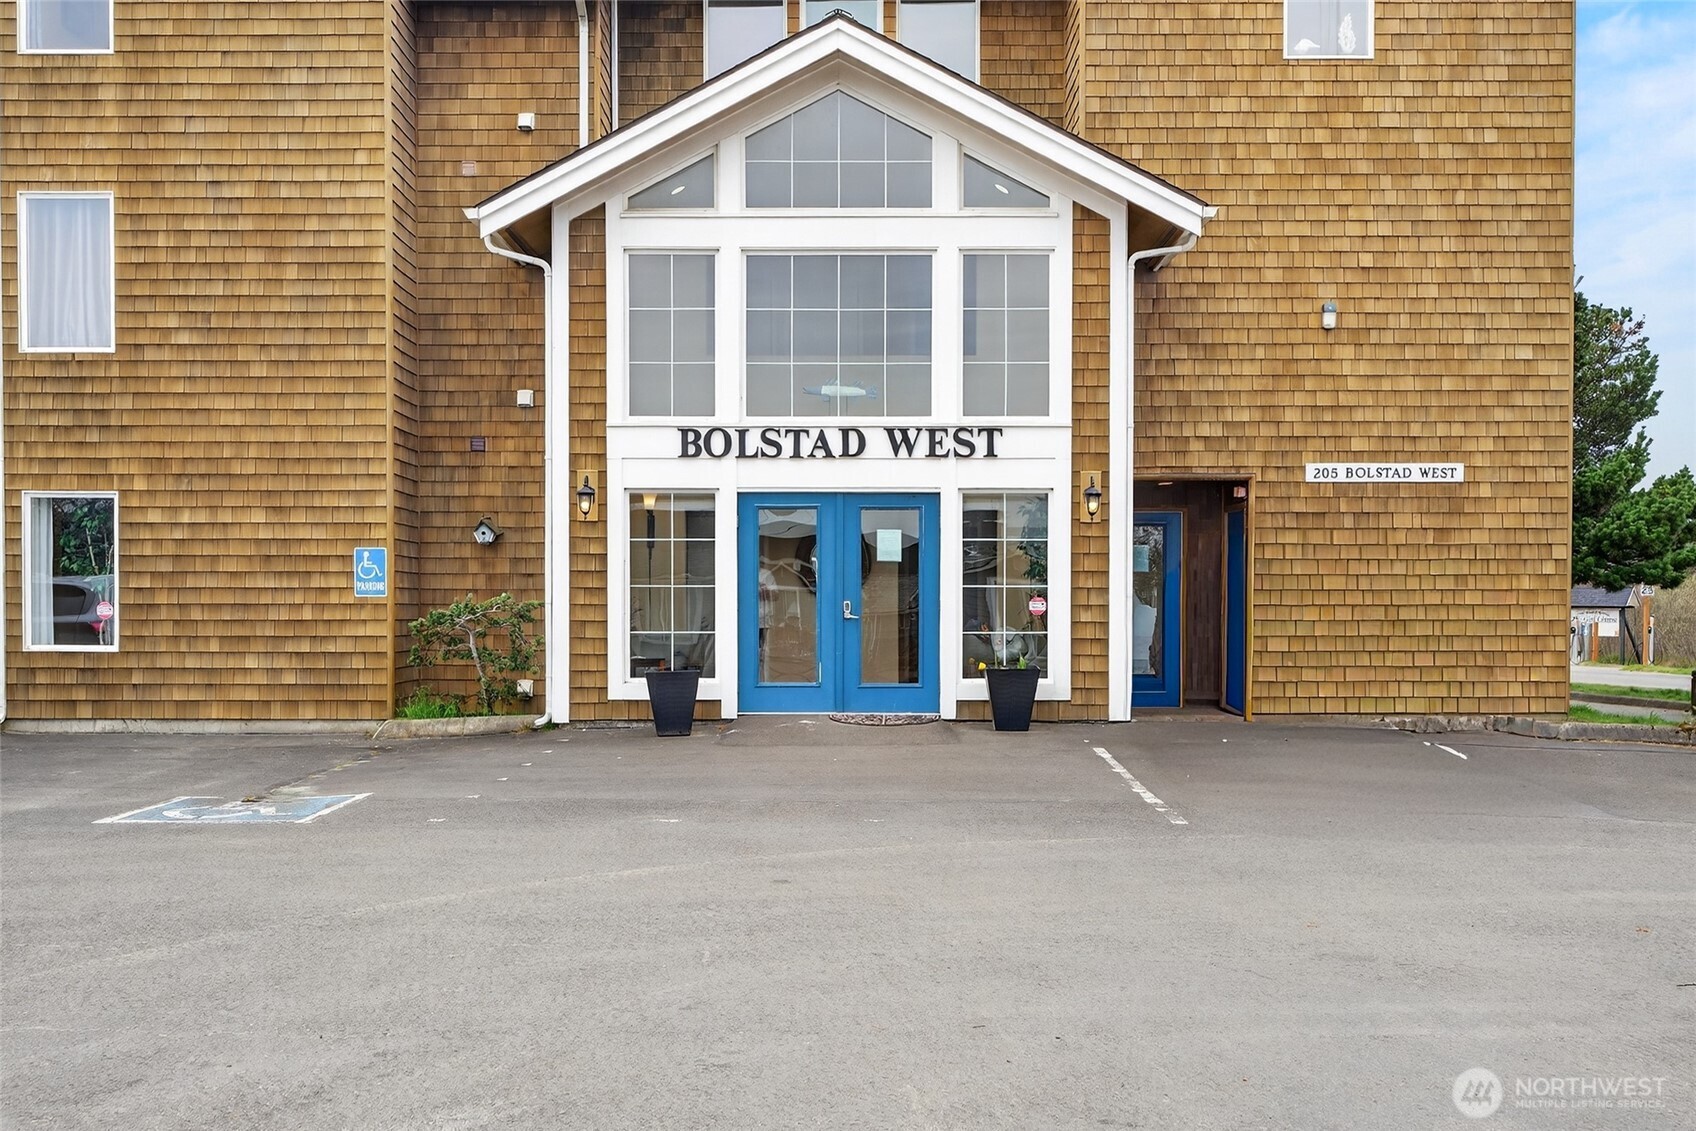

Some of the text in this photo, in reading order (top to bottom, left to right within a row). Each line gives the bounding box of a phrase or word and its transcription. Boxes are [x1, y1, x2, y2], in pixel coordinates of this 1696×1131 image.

[677, 427, 1003, 459] BOLSTAD WEST
[1313, 467, 1457, 479] 205 BOLSTAD WEST
